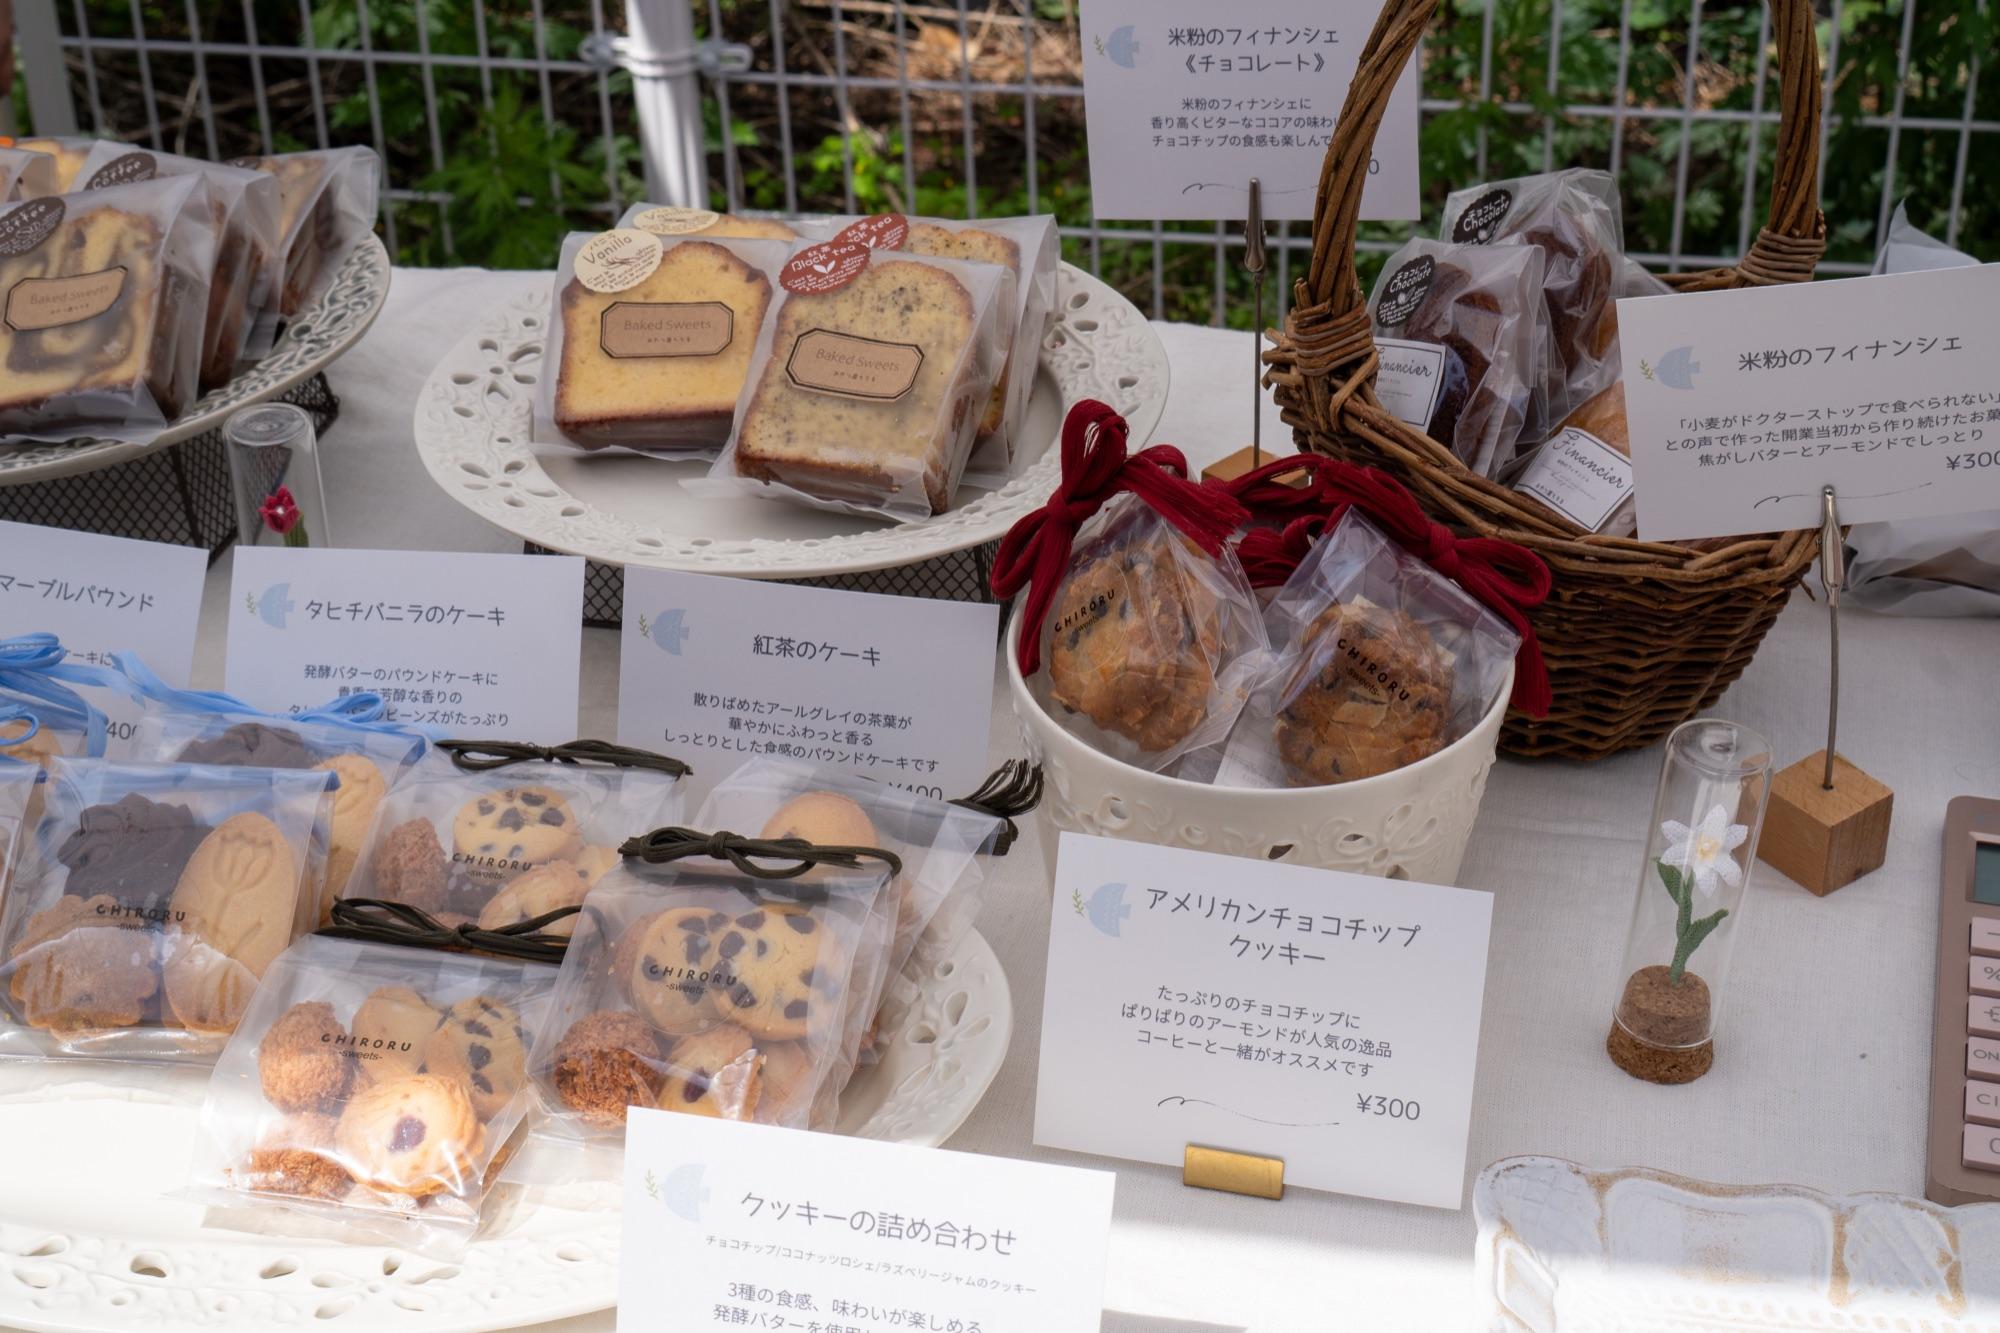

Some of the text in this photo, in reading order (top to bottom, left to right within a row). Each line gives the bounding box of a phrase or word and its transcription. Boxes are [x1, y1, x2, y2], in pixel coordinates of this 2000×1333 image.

[1168, 27, 1339, 47] 米粉のフィナンシェ
[1181, 97, 1312, 111] 米粉のフィナンシェに
[1463, 201, 1509, 231] Chocolate
[582, 236, 633, 265] Vanilla
[791, 253, 828, 272] Black
[832, 245, 856, 256] tea
[1390, 266, 1432, 293] Chocolate
[624, 319, 712, 331] Baked Sweets
[816, 347, 901, 373] Baked Sweets
[1738, 334, 1963, 371] 米粉のフィナンシェ
[1553, 432, 1625, 489] Financier
[1698, 428, 1983, 467] 焦がしバターとアーモンドでしっとり
[305, 599, 505, 627] タヒチバニラのケーキ
[1053, 588, 1116, 634] CHIRORU
[753, 634, 881, 667] 紅茶のケーキ
[304, 664, 498, 686] 発酵バターのパウンドケーキに
[1337, 638, 1410, 703] CHIRORU
[693, 692, 912, 730] 散りばめたアールグレイの茶葉が
[728, 717, 874, 747] 華やかにふわっと香る
[664, 727, 940, 773] しっとりとした食感のパウンドケーキです
[451, 852, 533, 874] CHIRORU
[96, 903, 187, 923] CHIRORU
[1146, 886, 1422, 948] アメリカンチョコチップ
[1229, 934, 1326, 965] クッキー
[648, 963, 738, 987] CHIRORU
[1157, 984, 1361, 1029] たっぷりのチョコチップに
[320, 1032, 413, 1053] CHIRORU
[1121, 1003, 1392, 1059] ぱりぱりのアーモンドが人気の逸品
[1137, 1028, 1374, 1078] コーヒーと一緒がオススメです
[1356, 1092, 1421, 1121] ¥300
[741, 1191, 1017, 1257] クッキーの詰め合わせ
